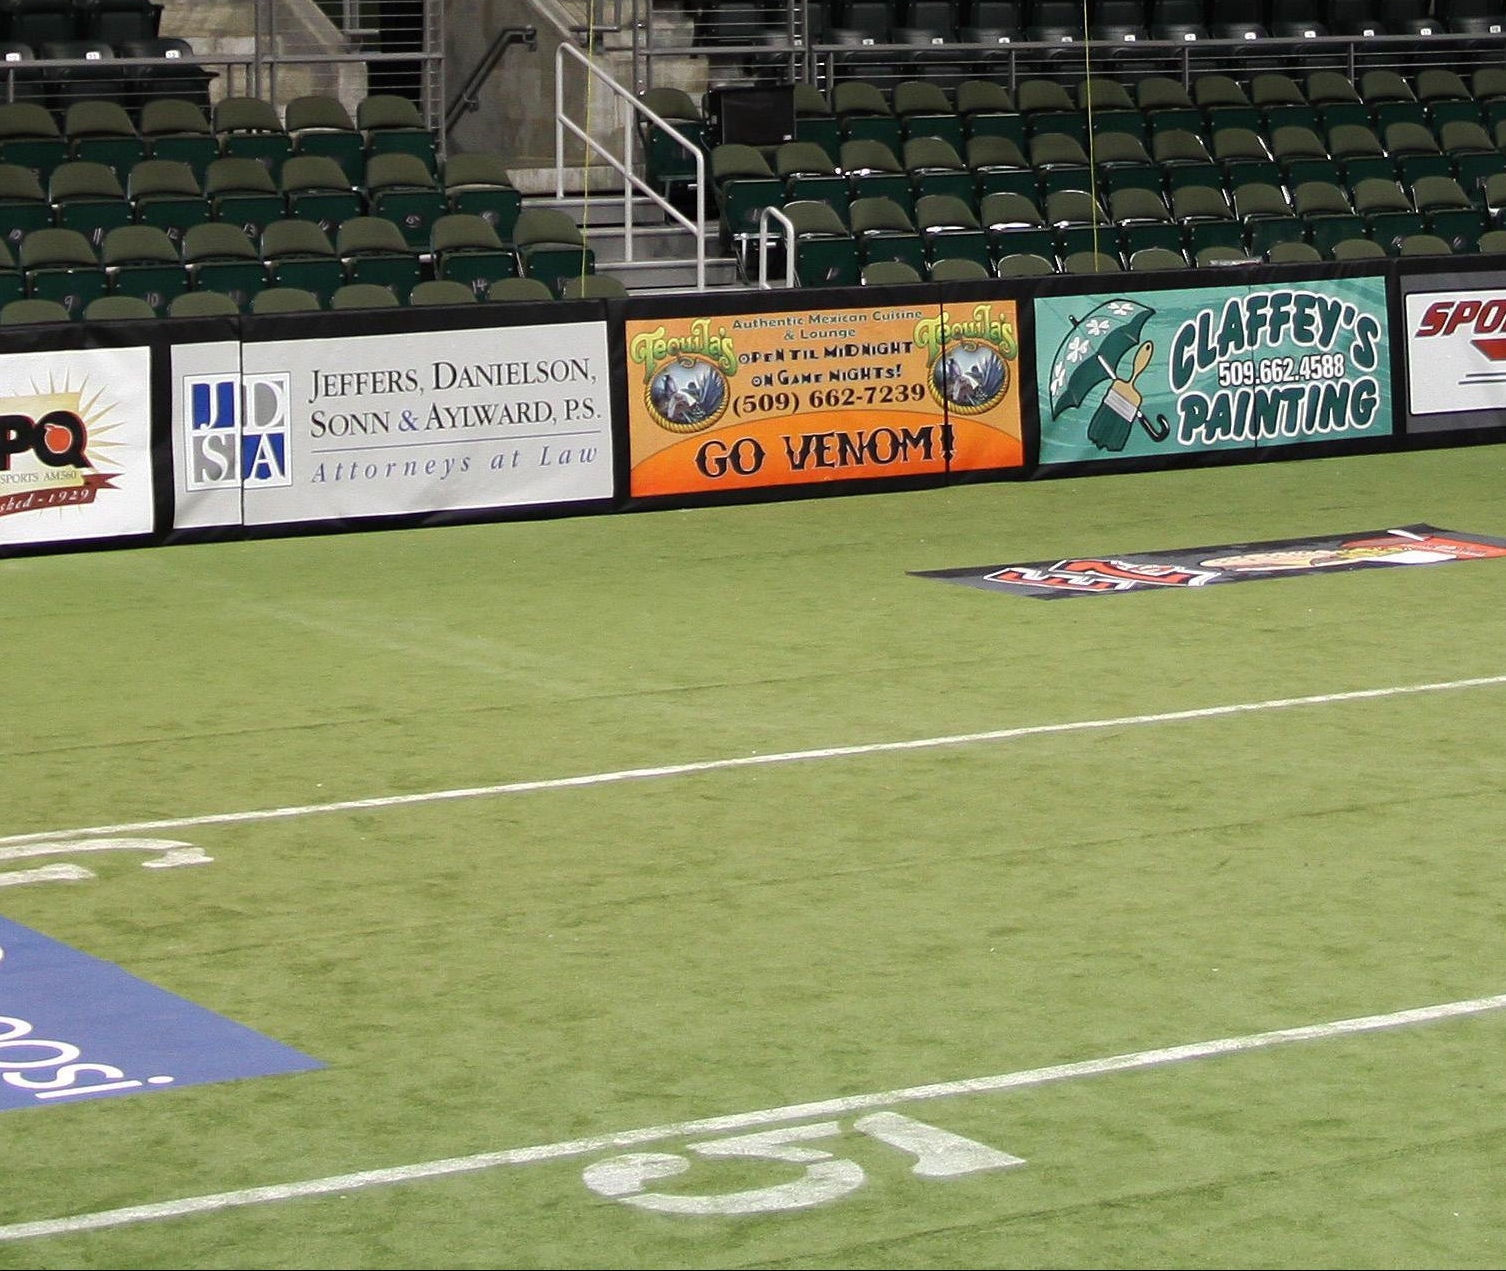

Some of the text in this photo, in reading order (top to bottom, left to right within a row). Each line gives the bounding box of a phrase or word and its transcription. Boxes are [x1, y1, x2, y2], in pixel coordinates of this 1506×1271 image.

[733, 310, 923, 330] Authentic Mexican Cuisine
[784, 328, 857, 341] & Lounge
[913, 304, 1018, 362] Tequila's
[630, 318, 739, 380] Tequila's
[738, 347, 785, 365] OPEN
[1169, 290, 1381, 394] CLAFFEY'S
[308, 357, 597, 403] JEFFERS, DANIELSON,
[1217, 354, 1345, 388] 509.662.4588
[310, 410, 391, 439] SONN
[397, 409, 419, 432] &
[424, 397, 557, 431] AYLWARD,
[733, 383, 925, 418] (509) 662-7239
[1177, 376, 1380, 446] PAINTING
[310, 444, 599, 483] Attorneys at Law
[695, 423, 955, 479] GO VENOM!
[0, 472, 39, 485] SPORTS
[48, 488, 90, 503] 1929
